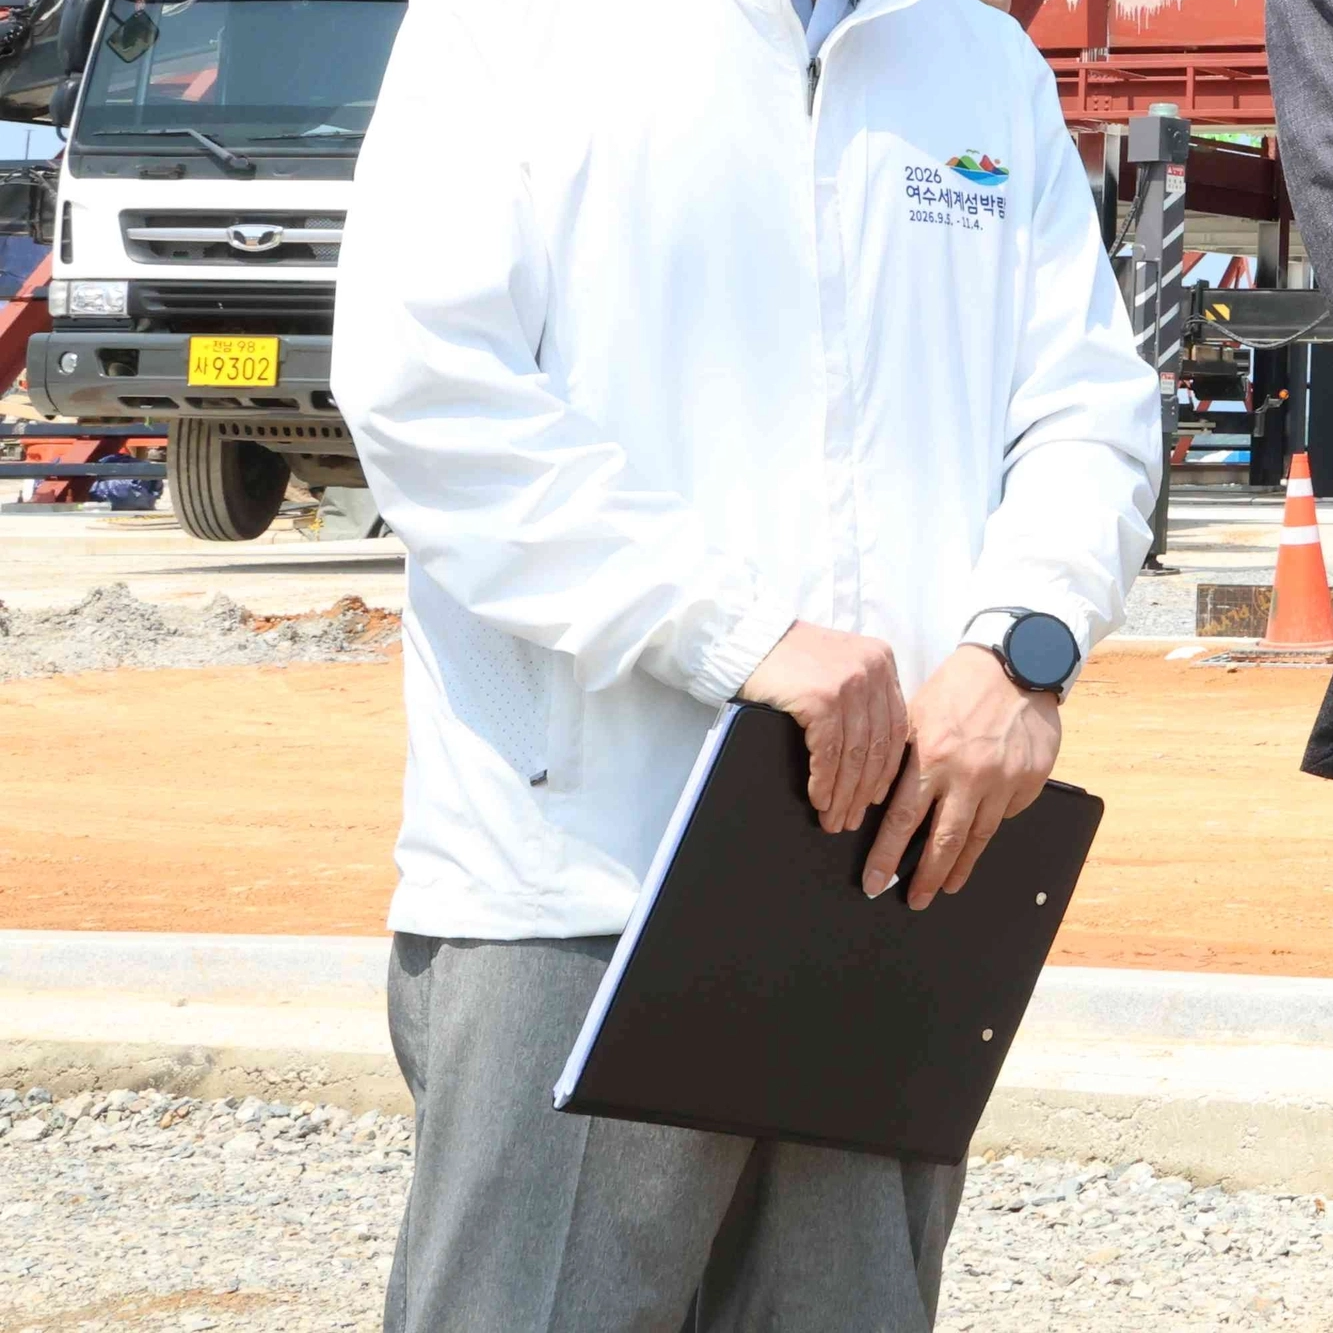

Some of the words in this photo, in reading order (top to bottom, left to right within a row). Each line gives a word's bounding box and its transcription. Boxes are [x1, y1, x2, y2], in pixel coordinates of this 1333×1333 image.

[905, 166, 942, 184] 2026
[213, 340, 233, 353] 전남
[237, 340, 256, 354] 98
